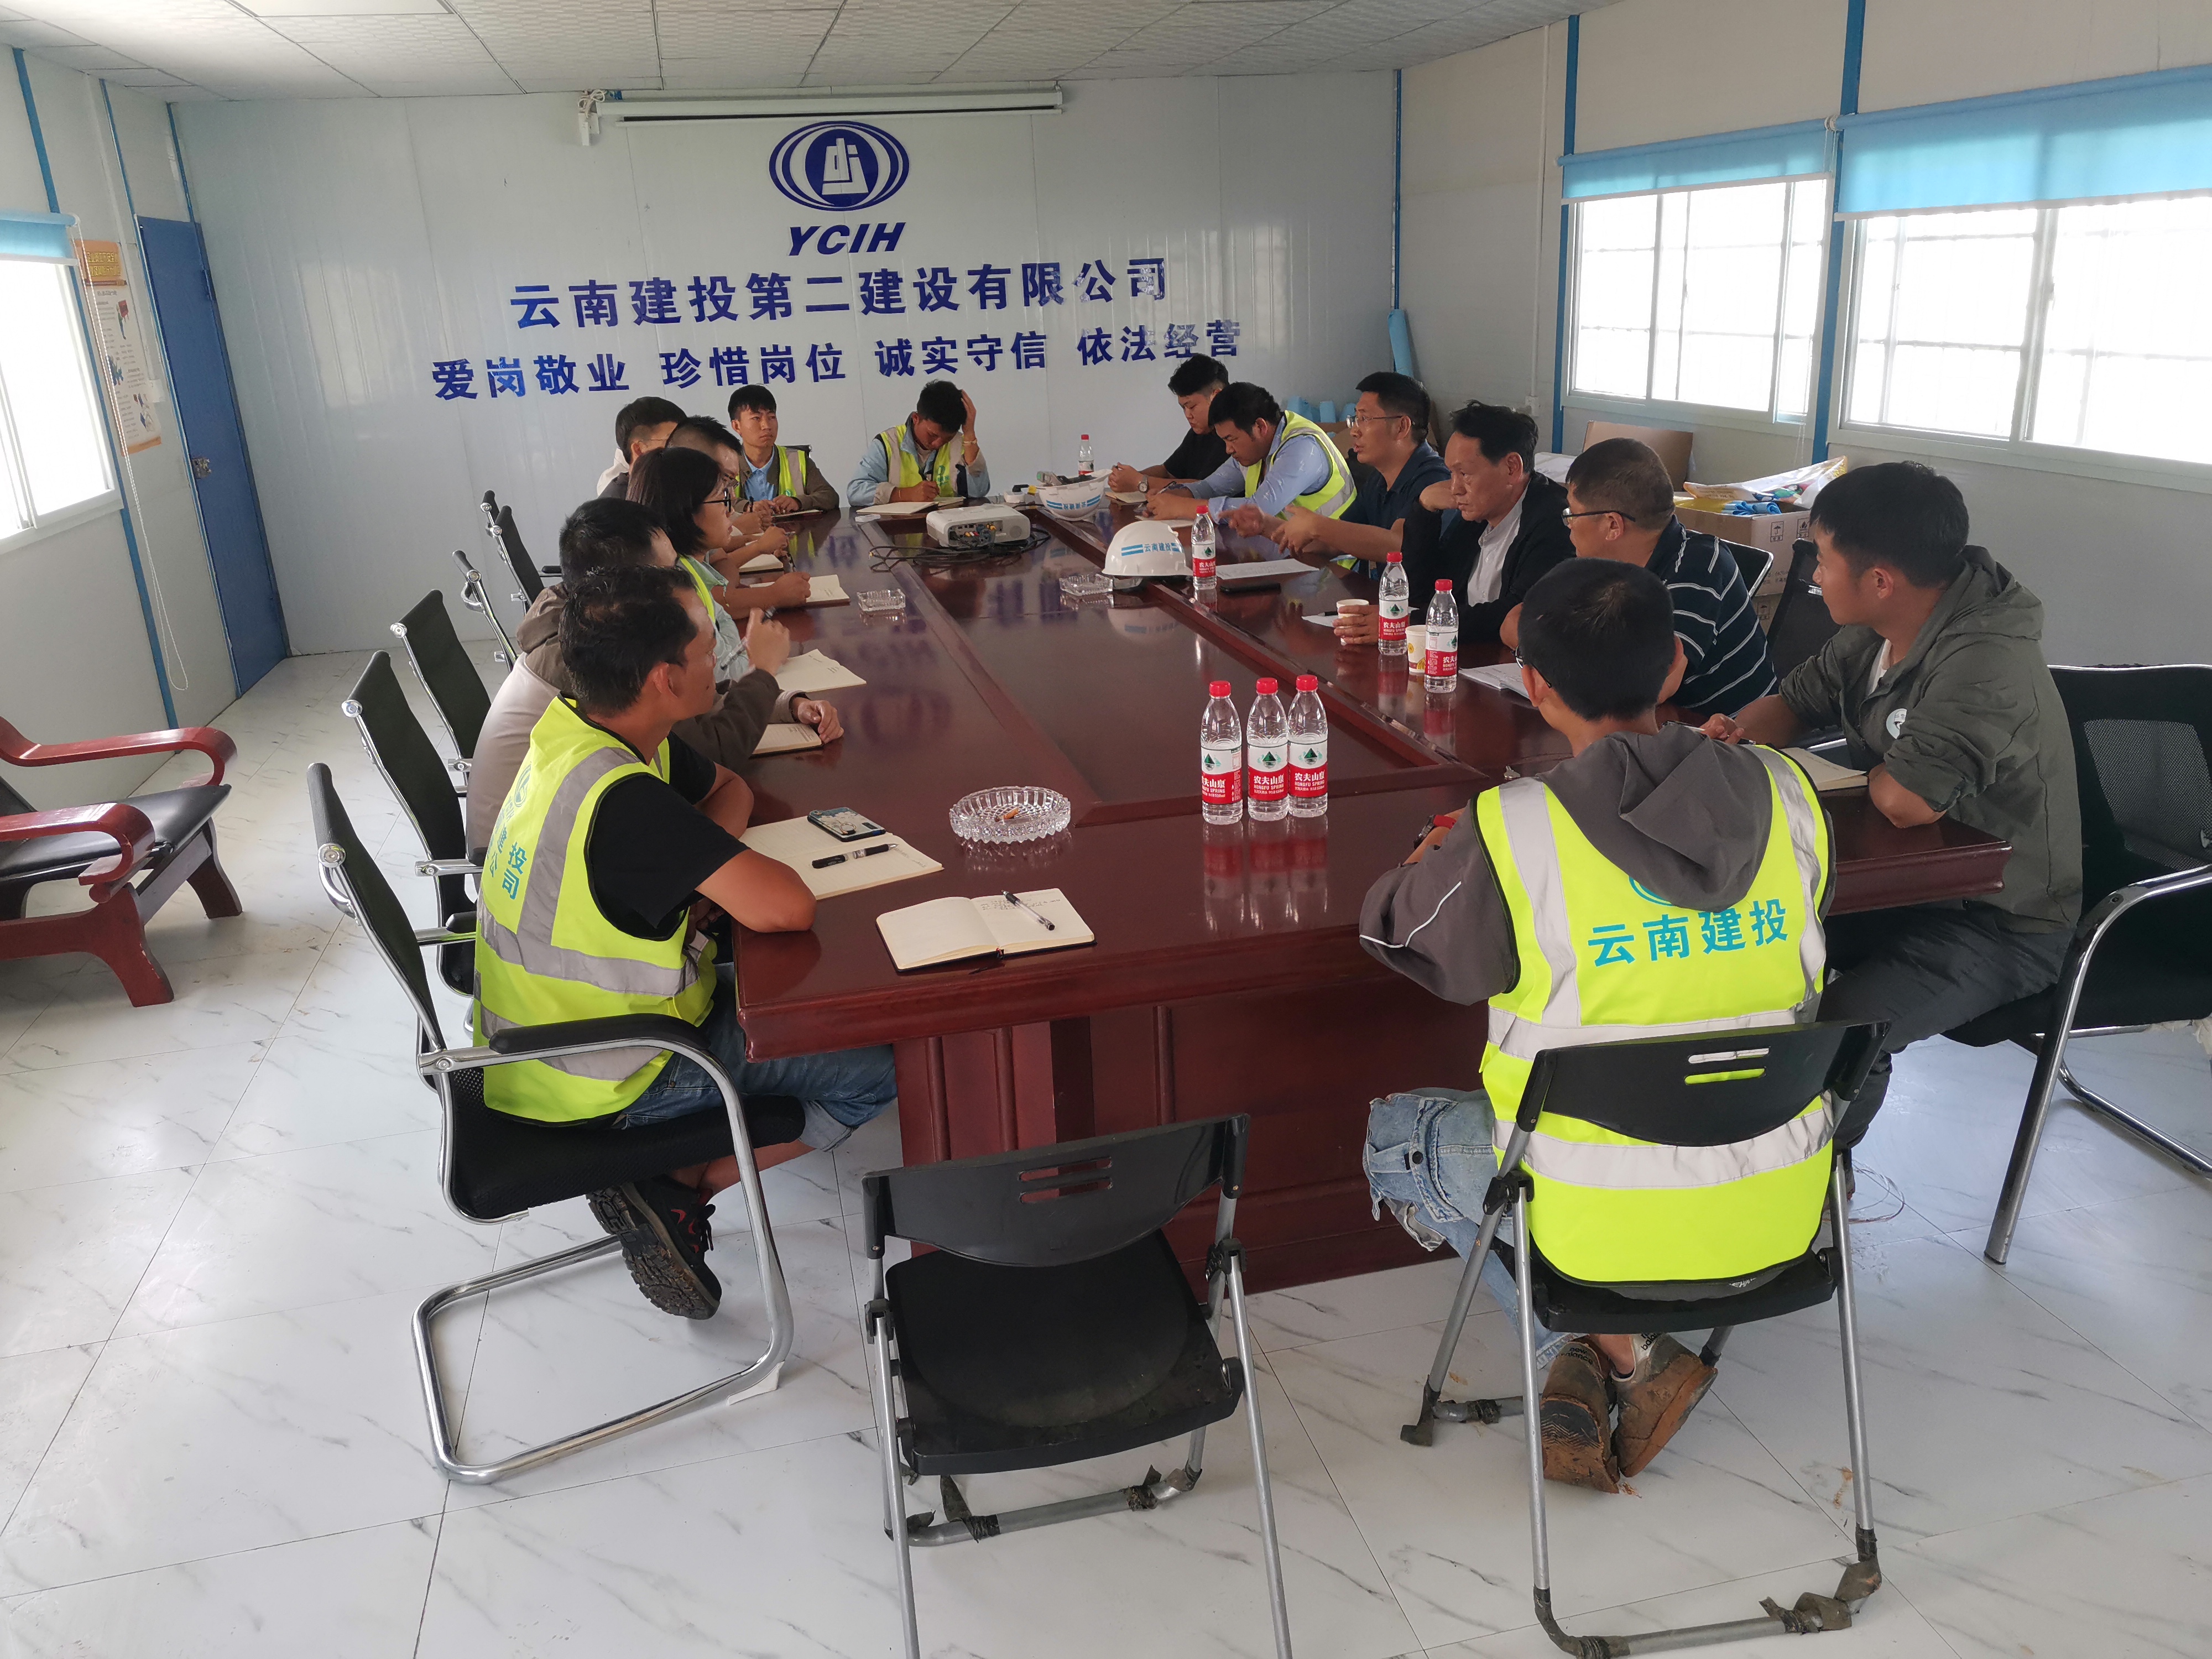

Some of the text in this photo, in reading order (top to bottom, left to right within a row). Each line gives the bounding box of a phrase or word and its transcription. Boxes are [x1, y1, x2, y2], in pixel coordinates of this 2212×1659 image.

[789, 222, 906, 256] YCIH
[509, 258, 1165, 329] 云南建投第二建设有限公司
[432, 319, 1240, 400] 爱岗敬业 珍惜岗位 诚实守信 依法经营
[1144, 542, 1171, 552] 云南建投
[1254, 774, 1284, 785] 农夫山泉
[1295, 770, 1325, 782] 农夫山泉
[1587, 898, 1788, 967] 云南建投
